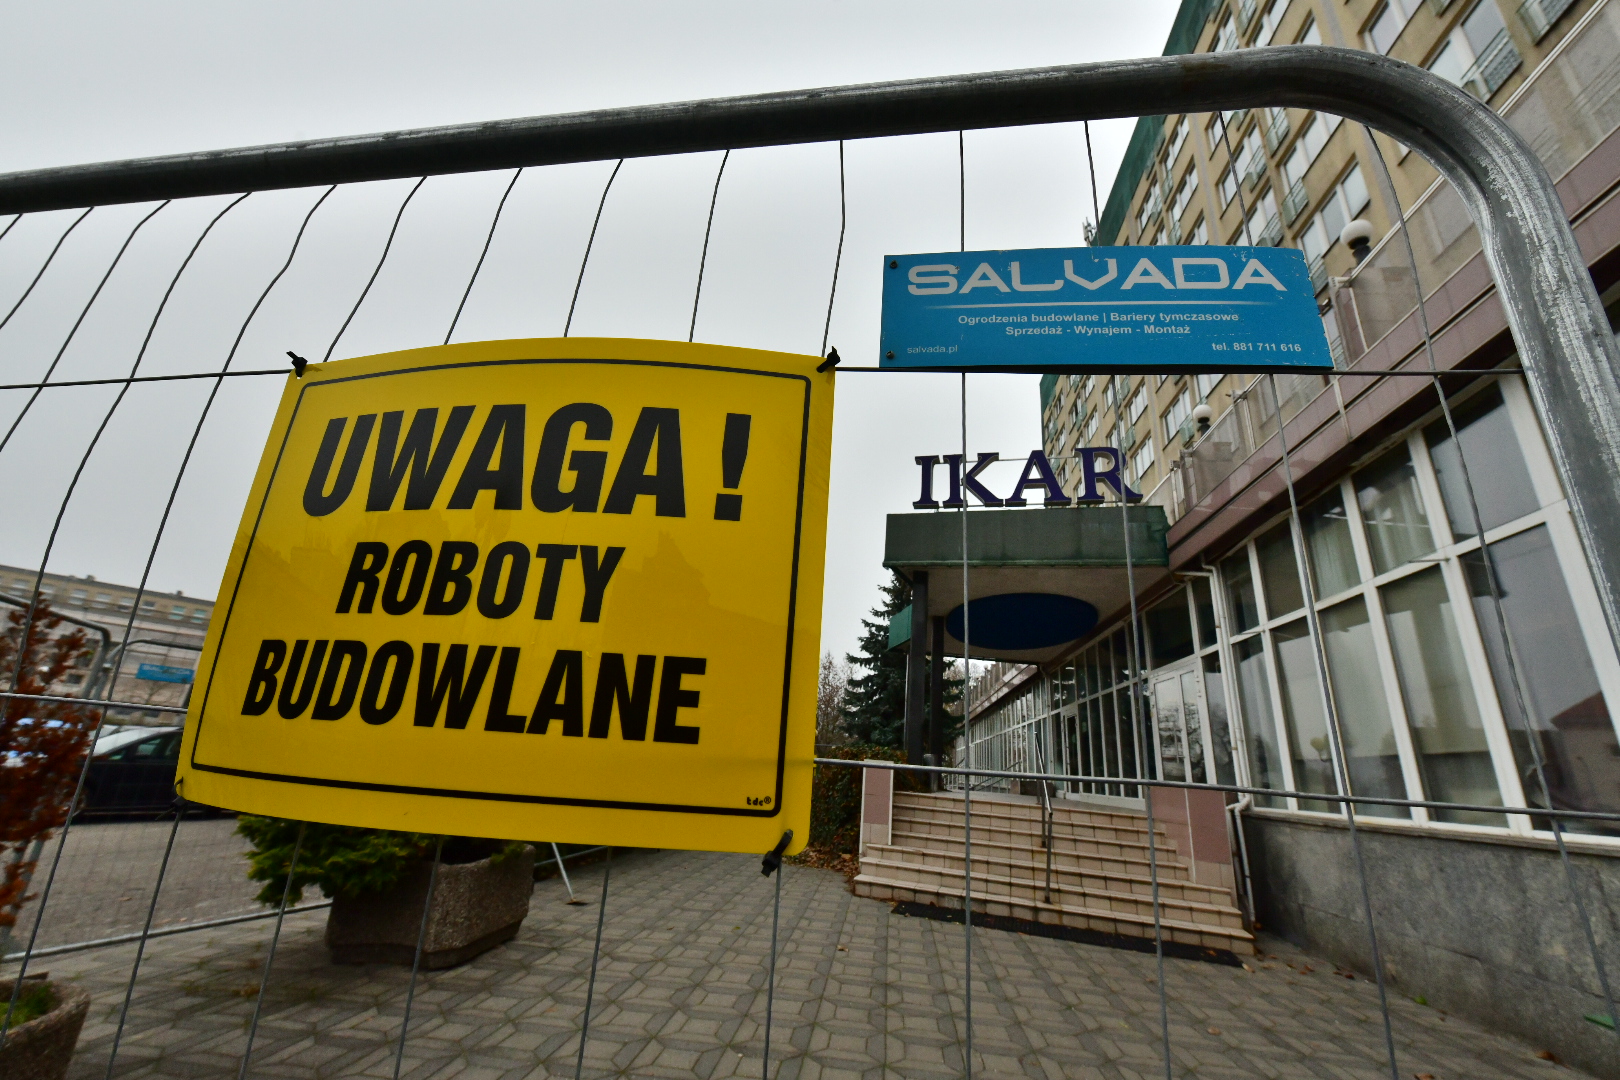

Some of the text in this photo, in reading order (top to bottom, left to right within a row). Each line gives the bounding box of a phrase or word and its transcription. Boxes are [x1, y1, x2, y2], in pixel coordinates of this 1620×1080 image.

[907, 257, 1288, 296] SALVADA
[958, 315, 1028, 326] Ogrodzenia
[1031, 313, 1099, 323] budowlane
[1110, 312, 1156, 323] Bariery
[1159, 312, 1239, 323] tymczasowe
[1005, 326, 1063, 337] Sprzedaż
[1073, 325, 1132, 336] Wynajem
[1143, 324, 1191, 334] Montaż
[907, 345, 958, 354] salvada.pl
[1211, 342, 1302, 352] tel. 881 711 616
[302, 403, 687, 518] UWAGA
[912, 446, 1144, 509] IKAR
[335, 539, 626, 623] ROBOTY
[241, 639, 707, 745] BUDOWLANE
